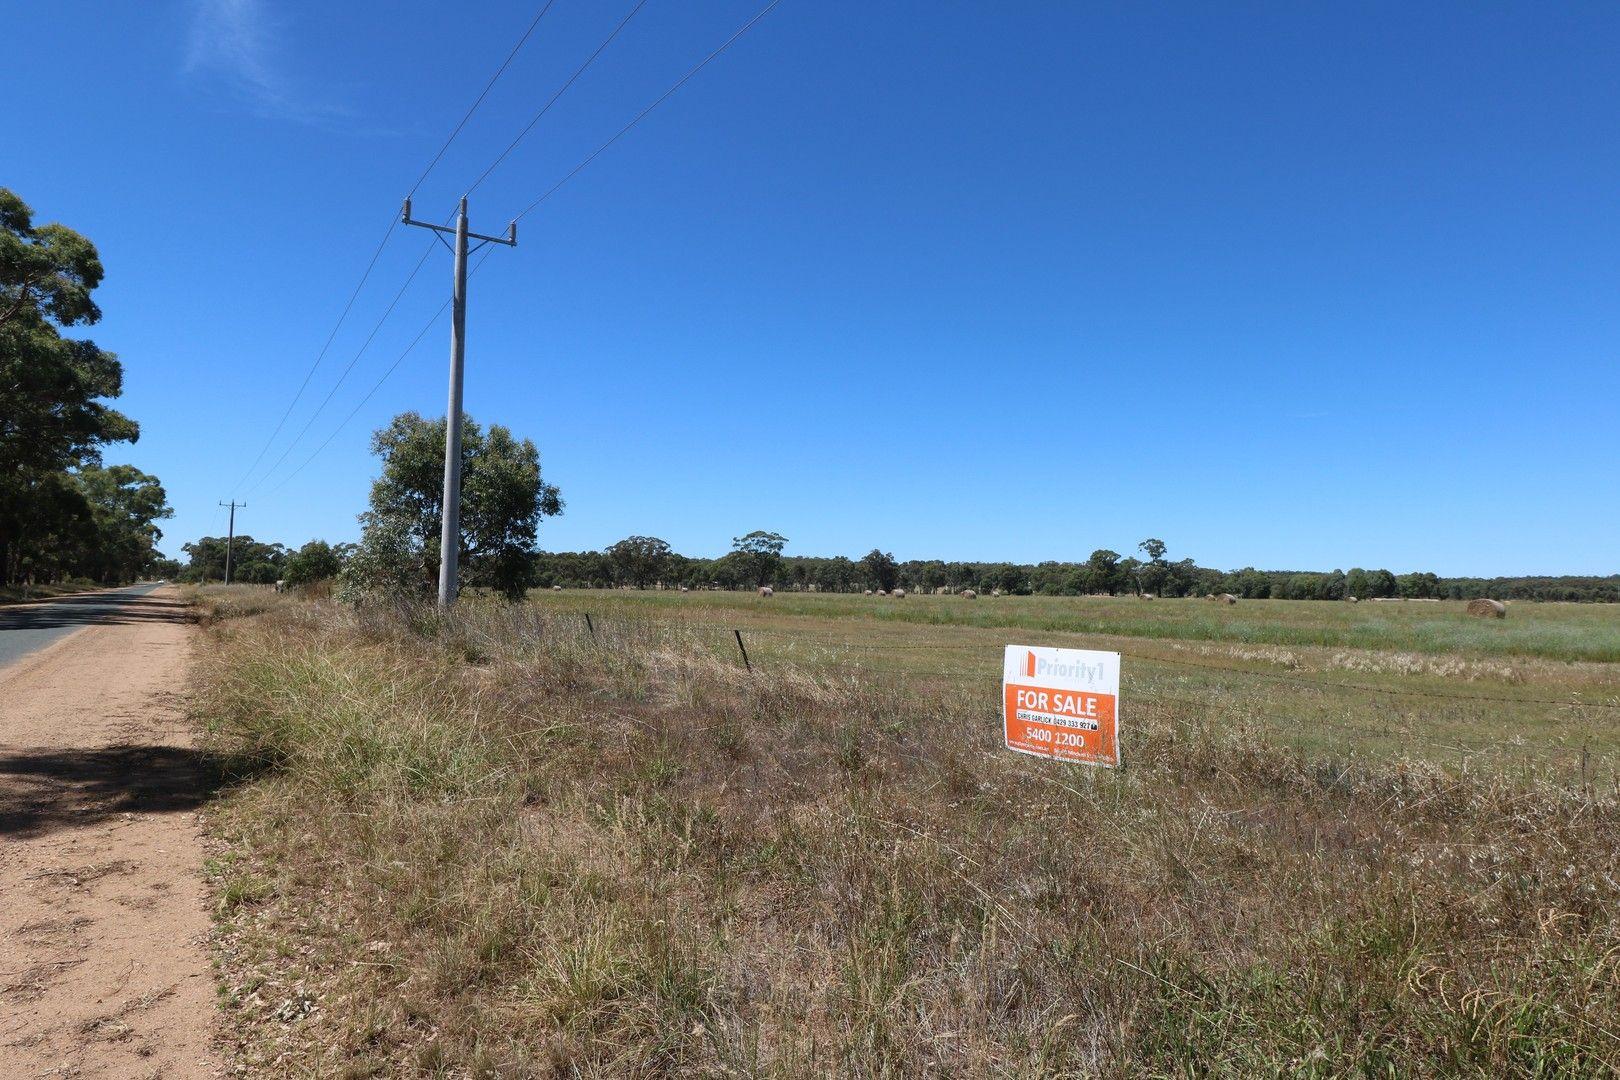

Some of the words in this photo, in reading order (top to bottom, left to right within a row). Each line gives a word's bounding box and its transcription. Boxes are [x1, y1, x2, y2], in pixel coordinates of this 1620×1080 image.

[1038, 657, 1104, 681] Priority1
[1017, 690, 1048, 711] FOR
[1053, 694, 1097, 716] SALE
[1017, 712, 1031, 721] CHRIS
[1032, 715, 1051, 724] GARLICK
[1068, 720, 1079, 728] 333
[1026, 727, 1052, 743] 5400
[1055, 732, 1084, 747] 1200
